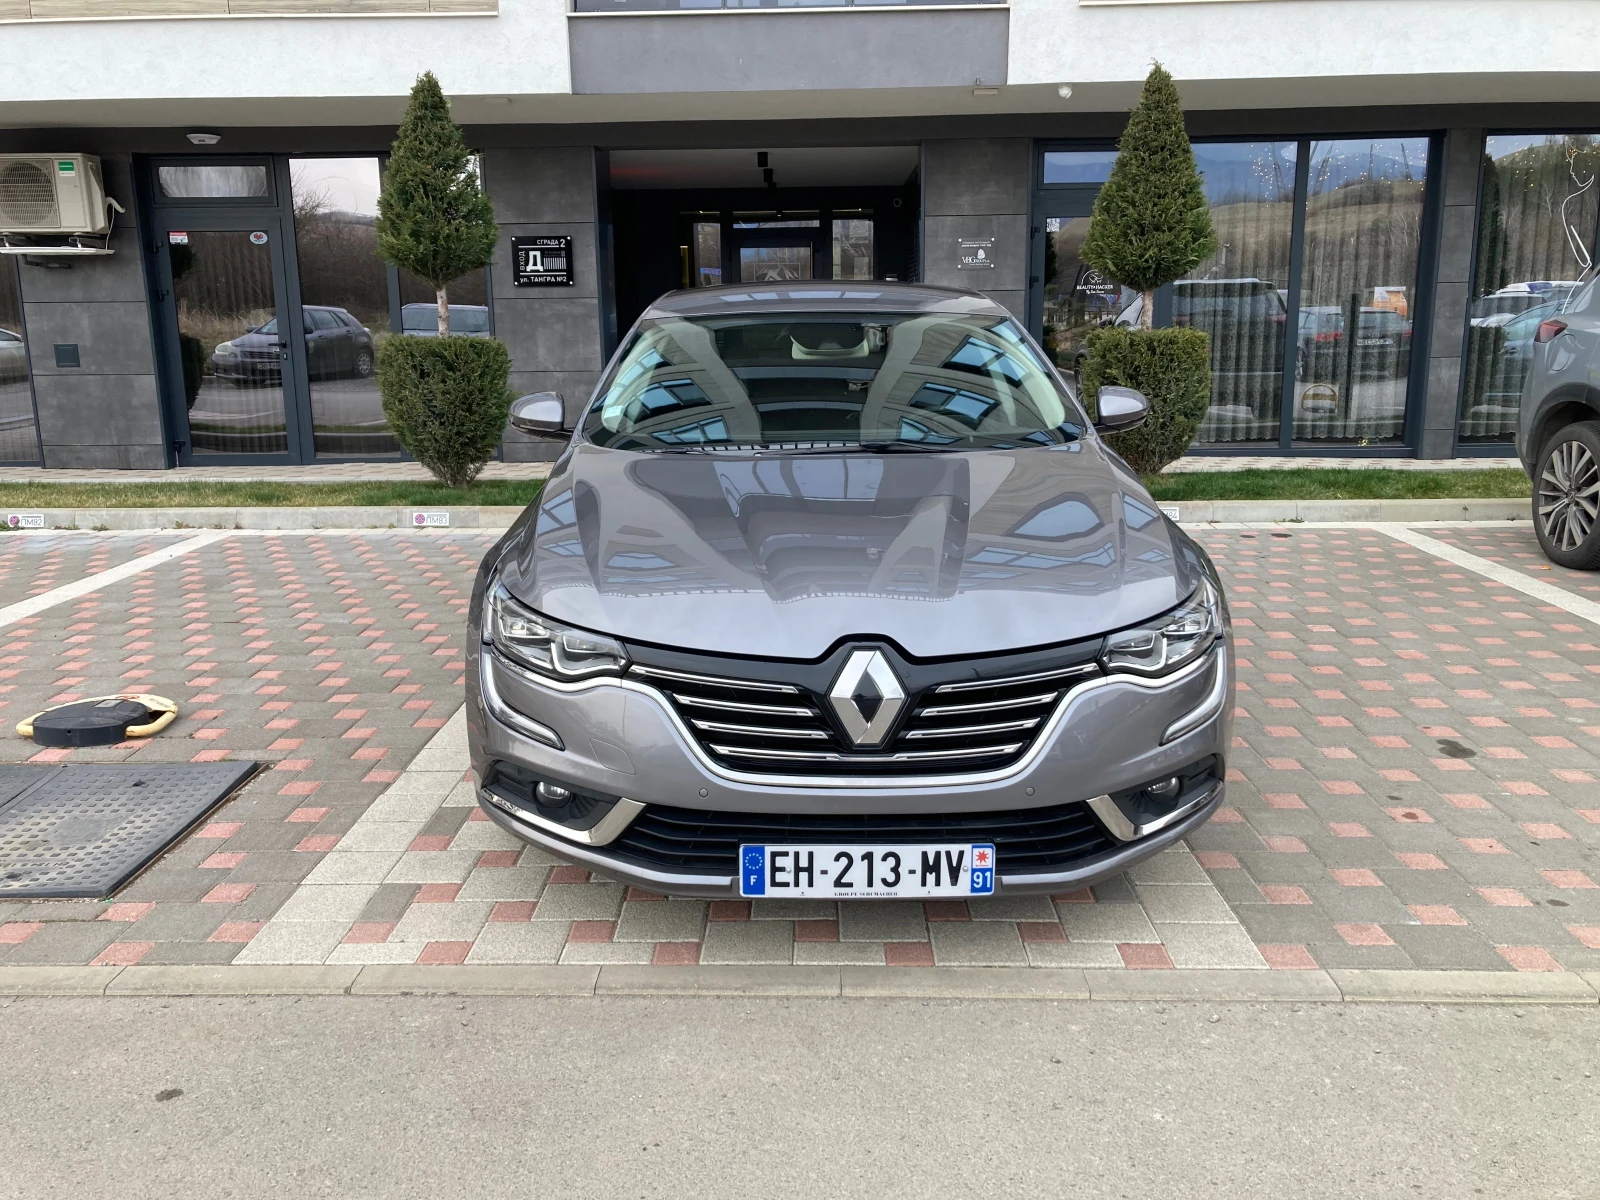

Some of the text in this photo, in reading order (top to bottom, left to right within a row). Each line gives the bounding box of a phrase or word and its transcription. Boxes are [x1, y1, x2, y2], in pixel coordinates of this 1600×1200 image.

[560, 239, 566, 247] 2
[526, 250, 544, 272] Д
[21, 518, 42, 526] ПМ82
[426, 516, 447, 524] ПМ83
[770, 850, 965, 888] EH-213-MV
[750, 875, 757, 886] F
[973, 871, 991, 888] 91
